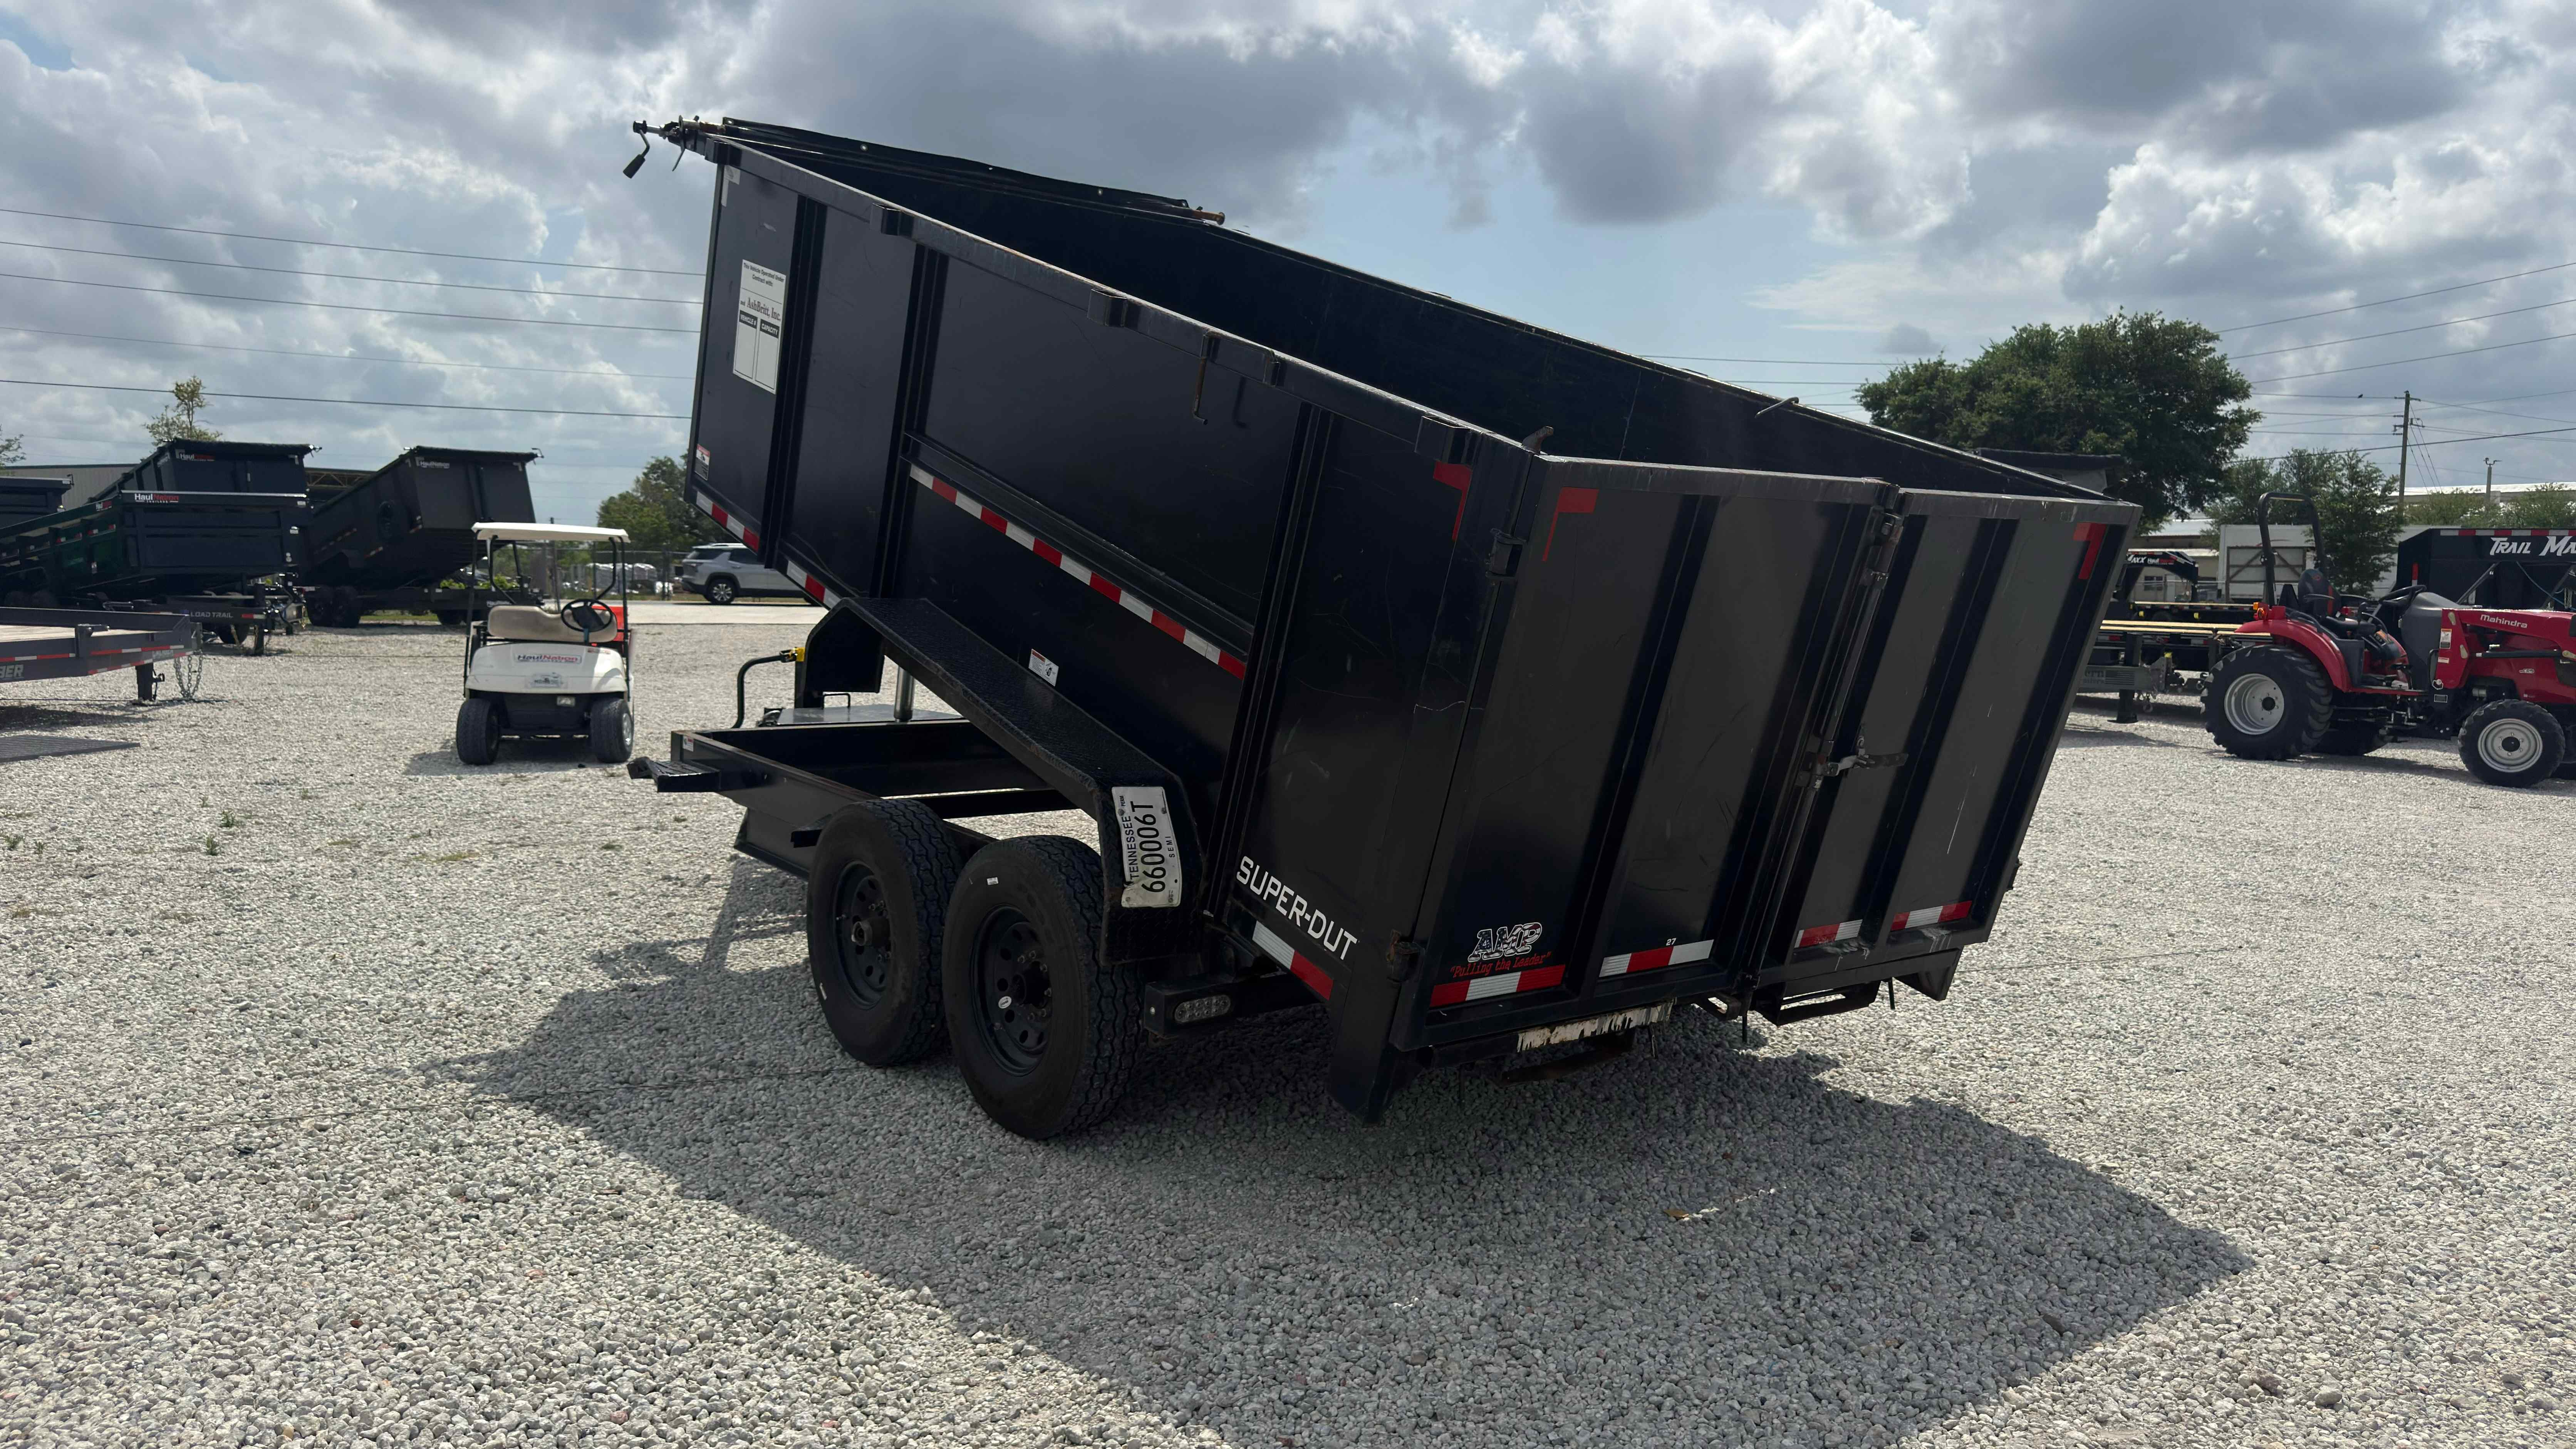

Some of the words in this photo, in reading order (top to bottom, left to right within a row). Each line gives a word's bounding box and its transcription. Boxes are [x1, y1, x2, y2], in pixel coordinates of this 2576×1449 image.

[747, 297, 770, 318] AshBritt,
[771, 307, 781, 321] Inc.
[761, 323, 778, 335] CAPACITY
[2490, 537, 2531, 555] TRAIL
[2480, 614, 2528, 628] Mahindra
[1121, 815, 1139, 880] TENNESSEE
[1130, 801, 1166, 892] 660006T
[1165, 836, 1175, 858] SEMI
[1236, 856, 1358, 960] SUPER-DUT
[1467, 922, 1542, 962] AMP
[1666, 937, 1677, 946] 27
[1495, 958, 1511, 971] the
